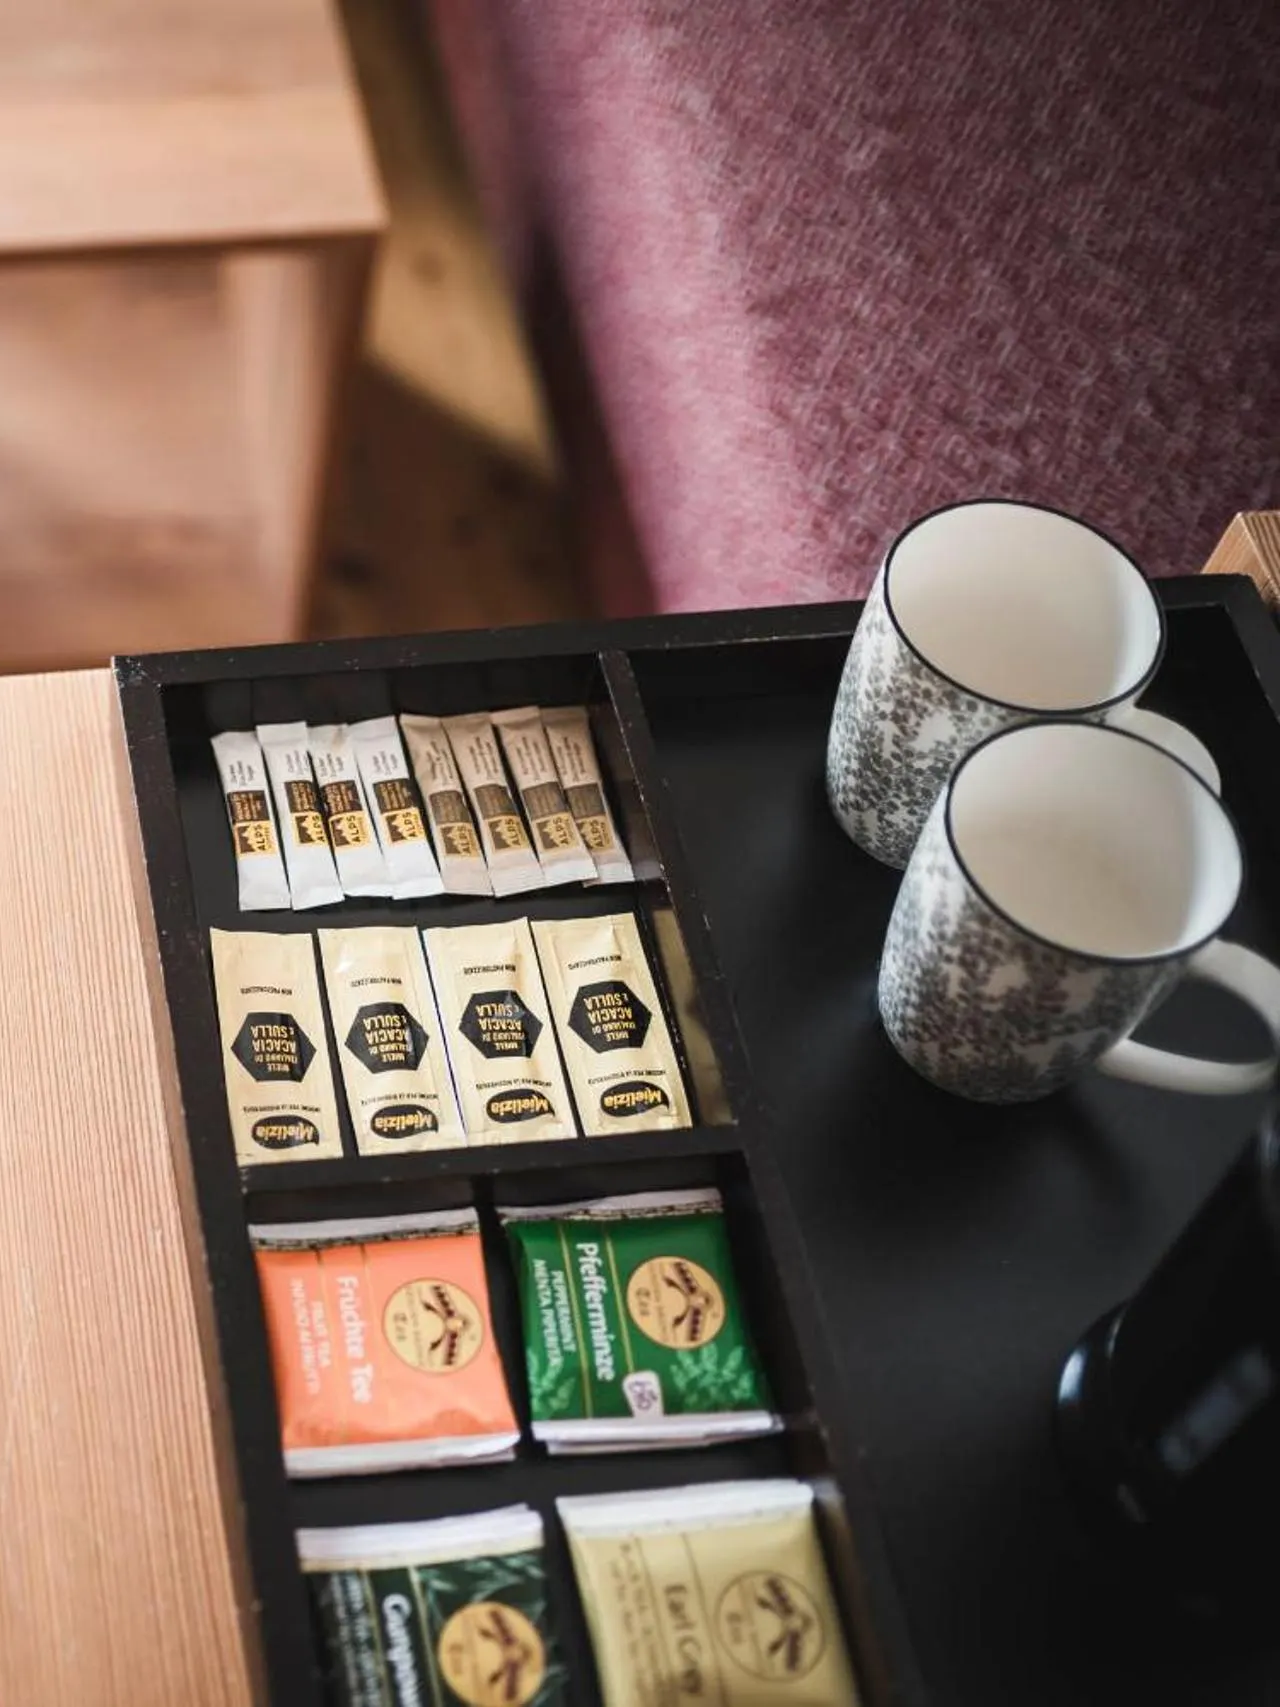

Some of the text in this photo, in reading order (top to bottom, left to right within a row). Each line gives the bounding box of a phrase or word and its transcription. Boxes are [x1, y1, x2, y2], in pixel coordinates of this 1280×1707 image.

[313, 815, 325, 842] ALPS
[346, 815, 360, 842] ALPS
[403, 812, 417, 837] ALPS
[505, 818, 520, 845] ALPS
[553, 817, 569, 844] ALPS
[590, 820, 604, 847] ALPS
[254, 824, 265, 851] ALPS
[457, 826, 471, 854] ALPS
[476, 1004, 512, 1017] SULLA
[584, 994, 622, 1008] SULLA
[363, 1016, 401, 1029] SULLA
[478, 1019, 521, 1030] ACACIA
[588, 1008, 632, 1022] ACACIA
[250, 1025, 287, 1038] SULLA
[365, 1029, 410, 1044] ACACIA
[252, 1040, 296, 1052] ACACIA
[491, 1095, 548, 1115] Mielizia
[603, 1088, 661, 1107] Mielizia
[256, 1122, 313, 1140] Mielizia
[375, 1111, 432, 1131] Mielizia
[534, 1260, 551, 1306] MENTA
[553, 1271, 575, 1350] PEPPERMINT
[578, 1243, 613, 1379] Pfefferminze
[352, 1364, 373, 1402] Tee
[662, 1581, 697, 1632] Earl
